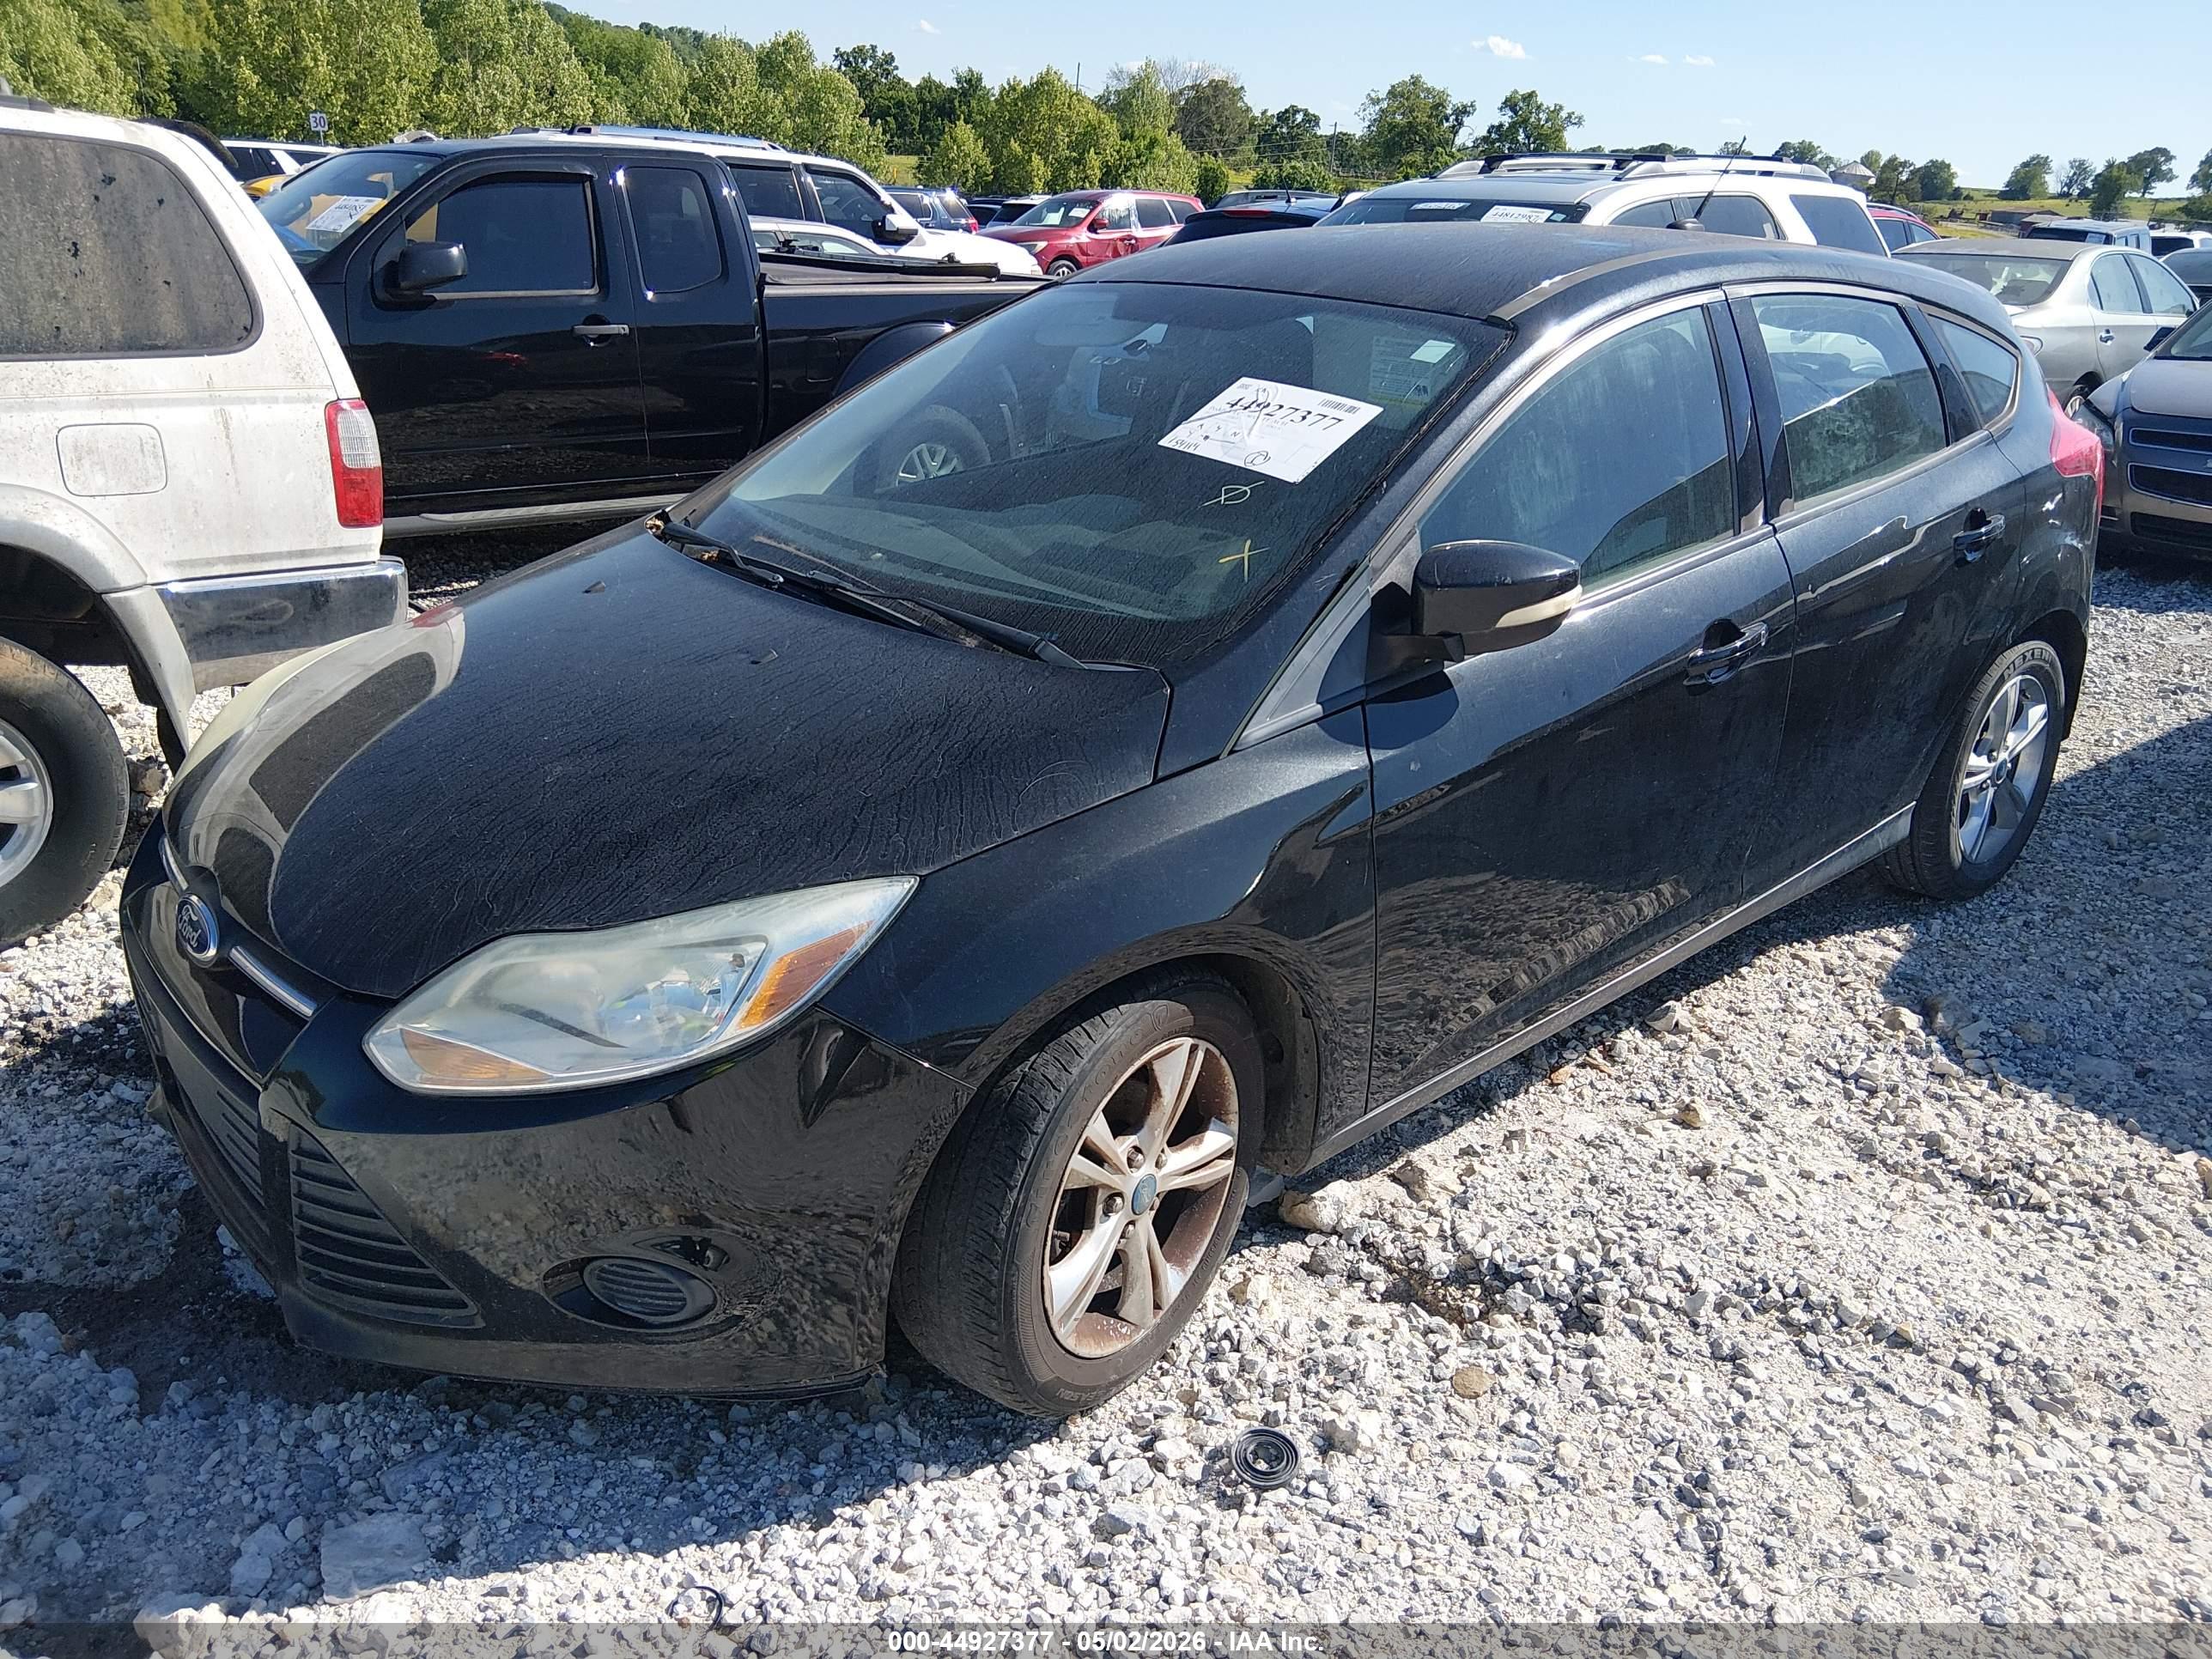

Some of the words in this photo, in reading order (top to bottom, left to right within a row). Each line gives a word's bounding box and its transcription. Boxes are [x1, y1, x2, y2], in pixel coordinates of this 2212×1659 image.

[312, 115, 326, 129] 30
[1226, 396, 1344, 431] 44927377
[2002, 647, 2053, 681] NEXEN
[178, 904, 202, 948] Ford
